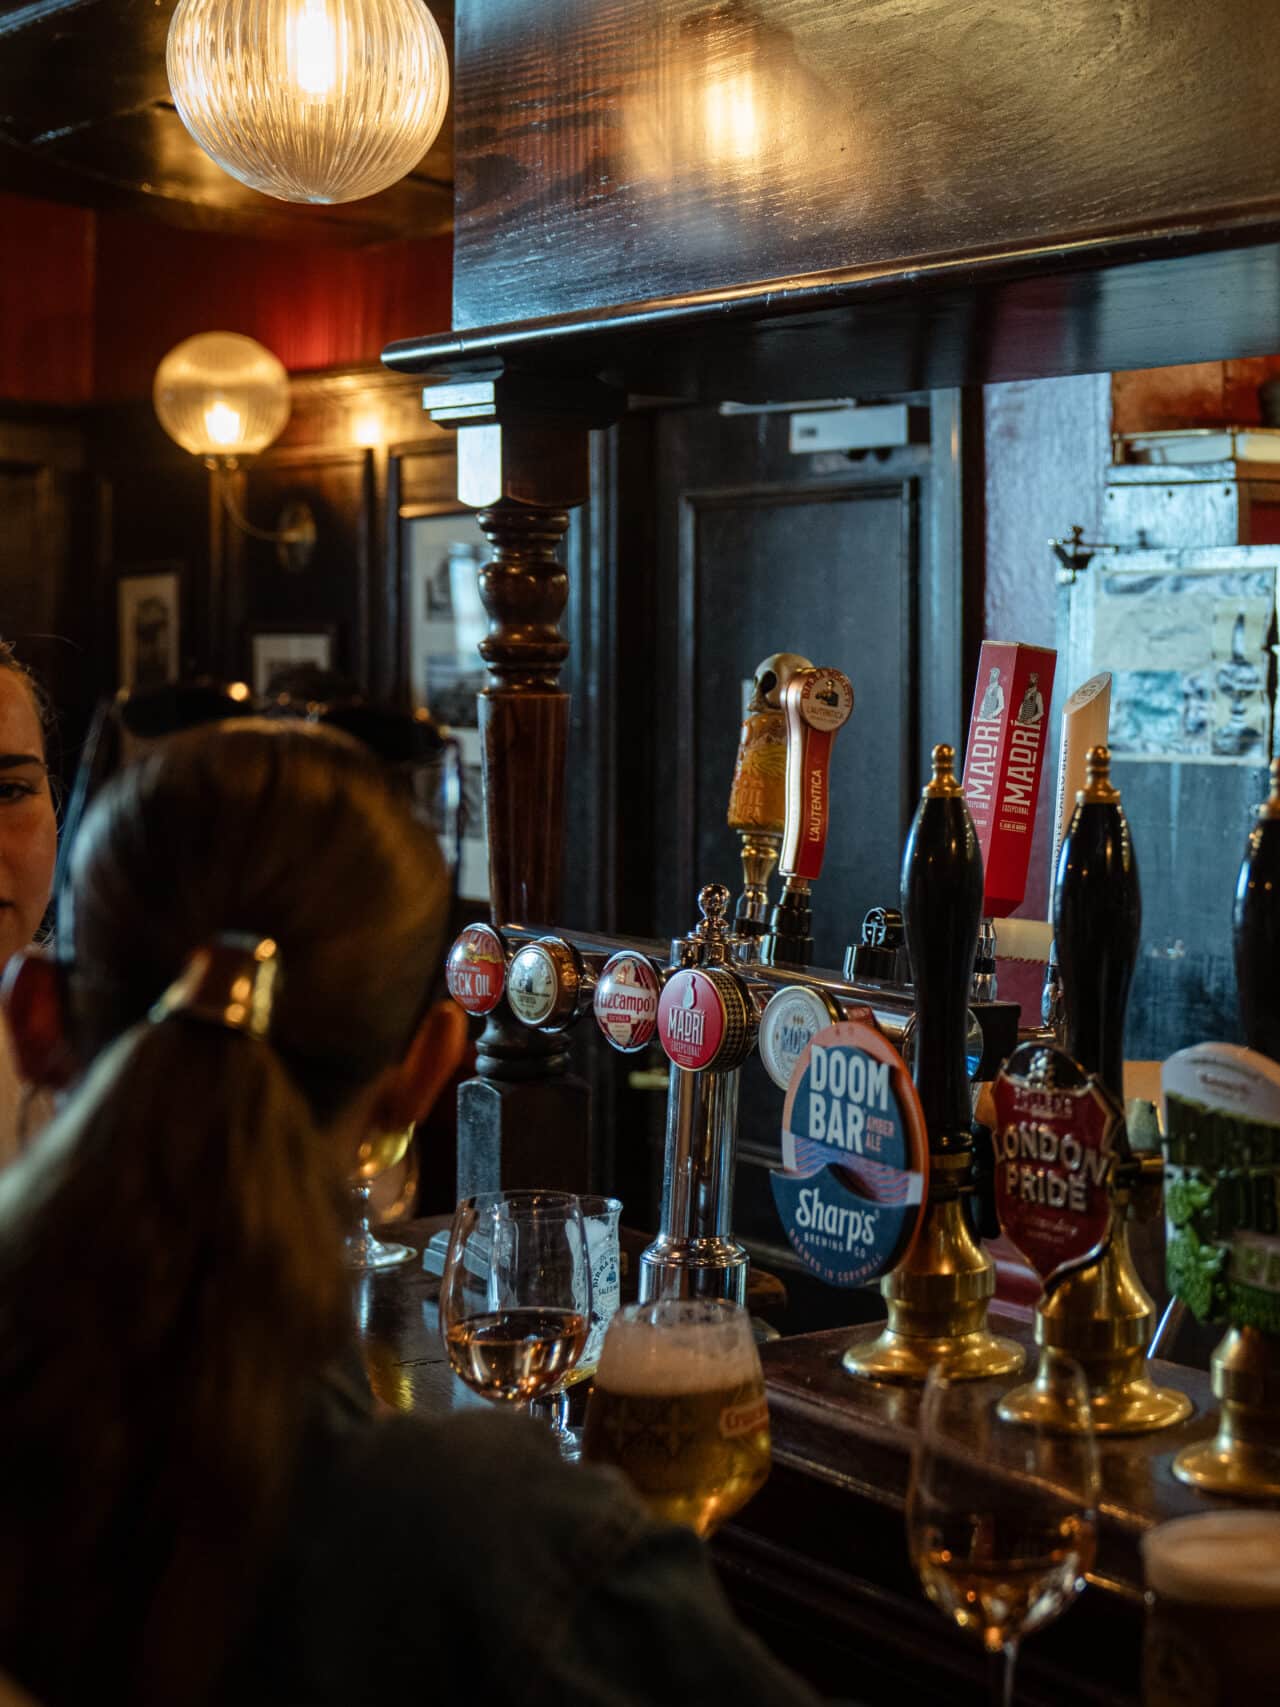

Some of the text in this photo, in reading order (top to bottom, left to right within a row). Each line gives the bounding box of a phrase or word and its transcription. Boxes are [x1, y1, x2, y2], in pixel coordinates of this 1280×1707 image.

[966, 715, 1002, 801] MADRÍ
[1003, 719, 1041, 807] MADRÍ
[809, 769, 823, 843] L'AUTENTICA
[475, 973, 492, 997] OIL
[667, 1007, 705, 1046] MADRÍ
[810, 1044, 890, 1112] DOOM
[808, 1092, 865, 1154] BAR
[865, 1136, 882, 1153] ALE
[866, 1116, 895, 1137] AMBER
[992, 1121, 1111, 1187] LONDON
[1006, 1161, 1087, 1212] PRIDE
[795, 1187, 877, 1251] Sharp's
[803, 1231, 844, 1253] BREWING
